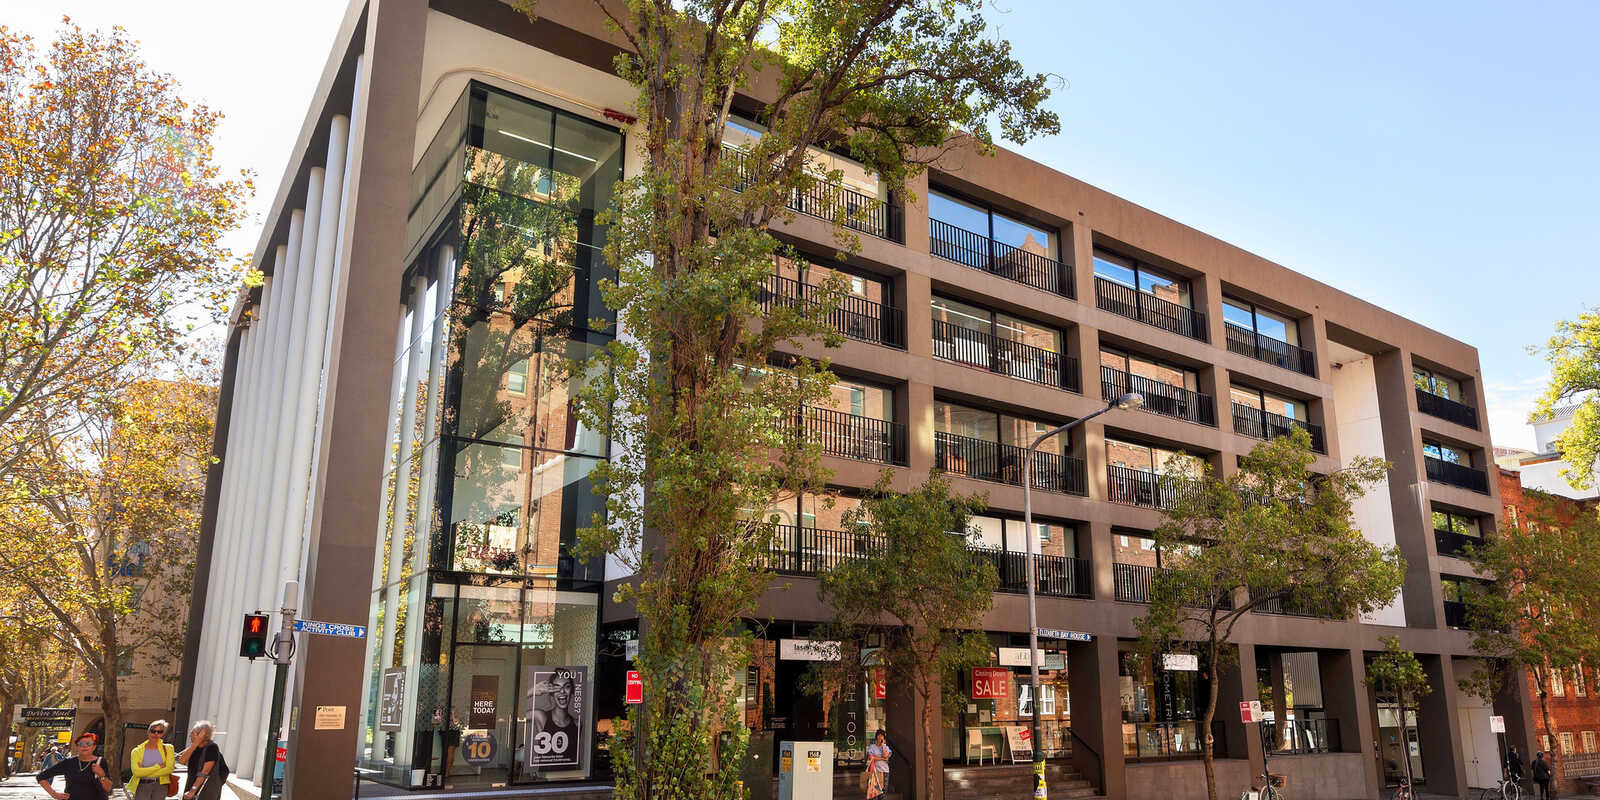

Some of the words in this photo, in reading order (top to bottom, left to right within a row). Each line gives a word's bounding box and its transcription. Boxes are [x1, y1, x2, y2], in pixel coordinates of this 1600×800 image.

[328, 623, 355, 632] CROSS
[335, 629, 355, 637] CLUB
[1039, 629, 1059, 638] ELIZABETH
[1060, 631, 1069, 639] BAY
[1070, 632, 1086, 641] HOUSE
[558, 671, 577, 679] YOU
[975, 680, 1007, 696] SALE
[574, 684, 582, 713] NESS?
[534, 731, 569, 754] 30
[847, 711, 857, 761] FOOD
[468, 742, 491, 758] 10
